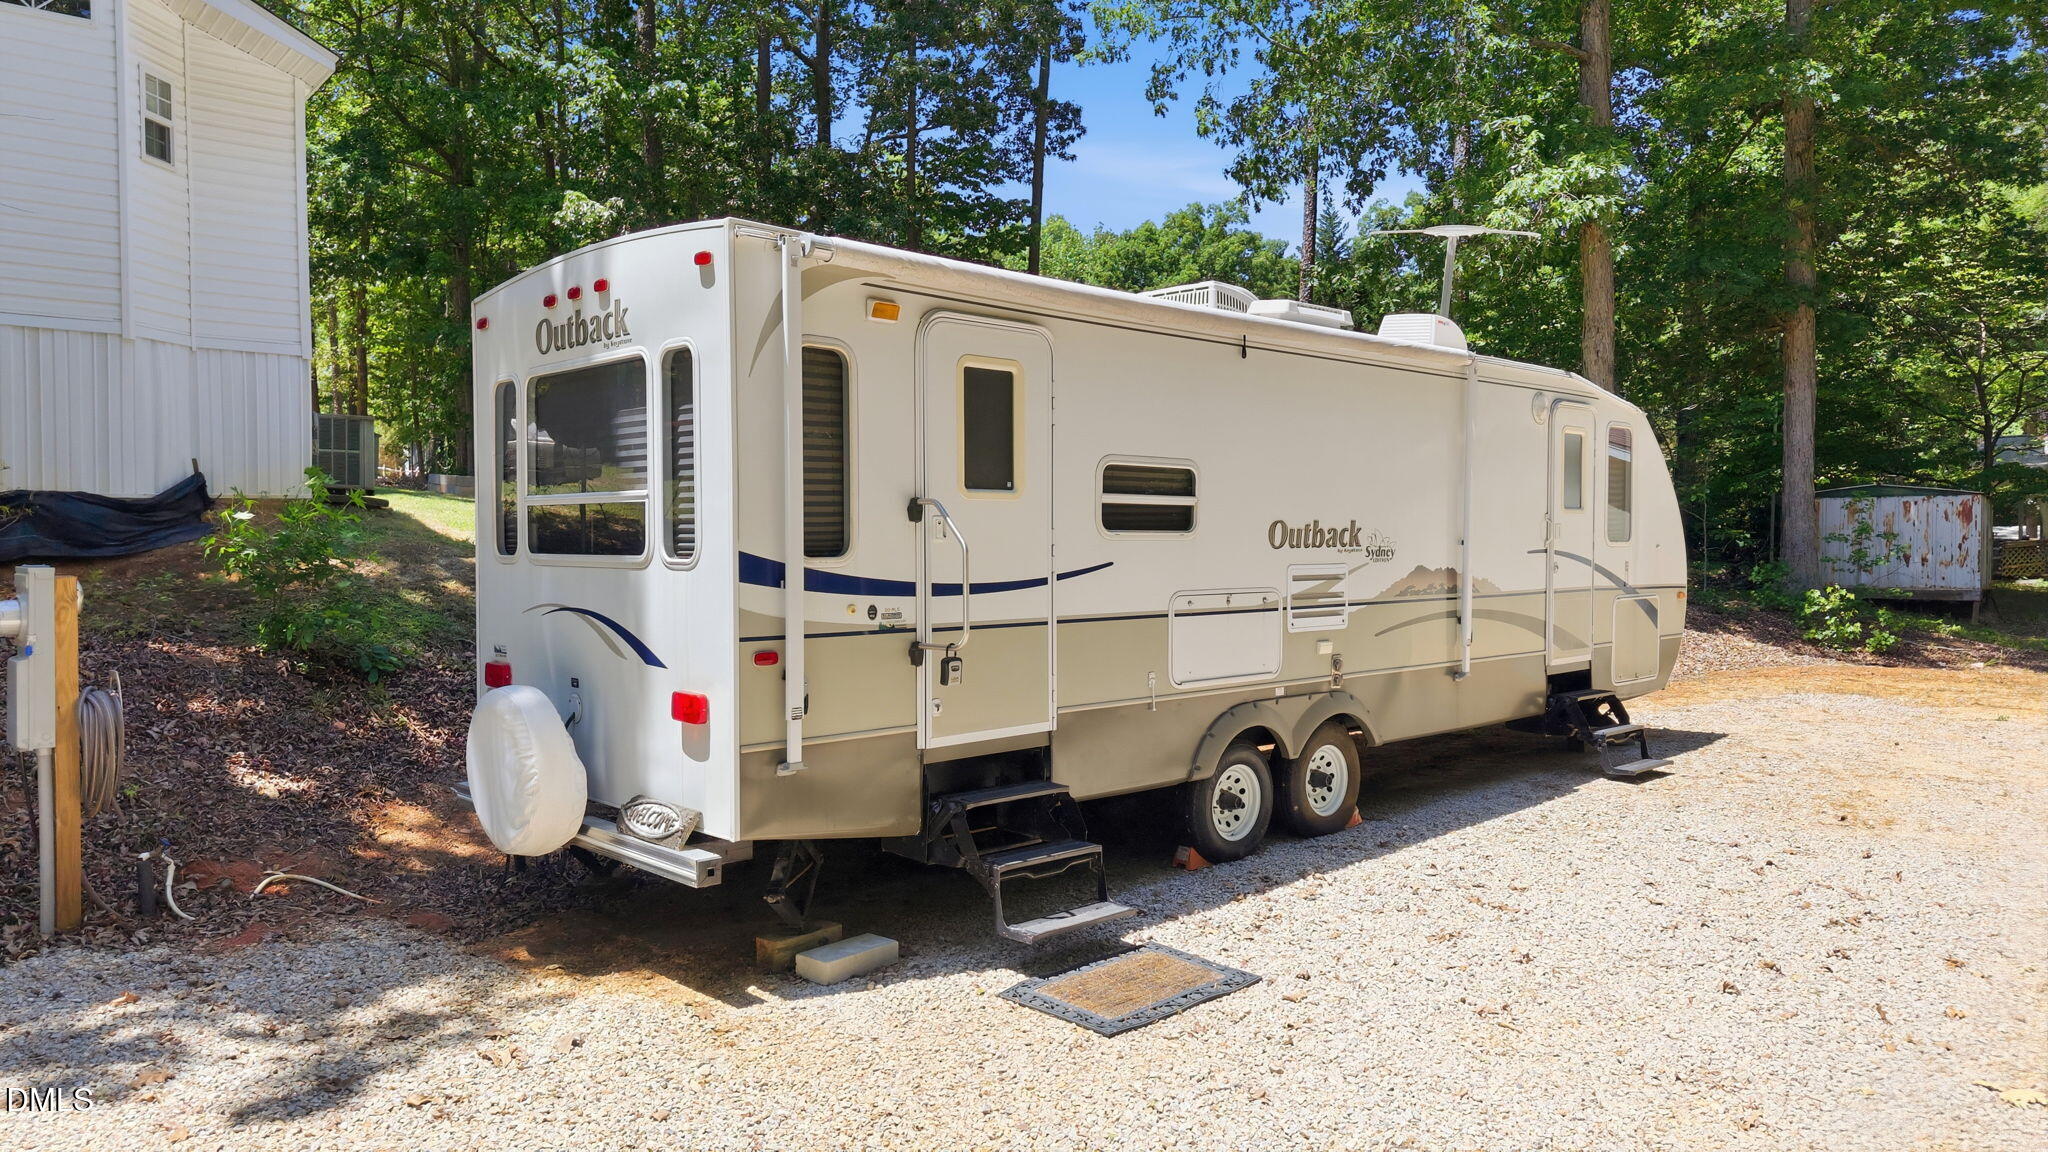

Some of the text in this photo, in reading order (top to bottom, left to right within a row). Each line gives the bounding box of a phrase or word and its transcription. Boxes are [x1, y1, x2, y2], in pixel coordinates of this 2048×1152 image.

[535, 298, 631, 355] Outback
[1267, 519, 1362, 550] Outback
[1364, 545, 1396, 561] Sydney
[627, 804, 680, 833] WELCOME
